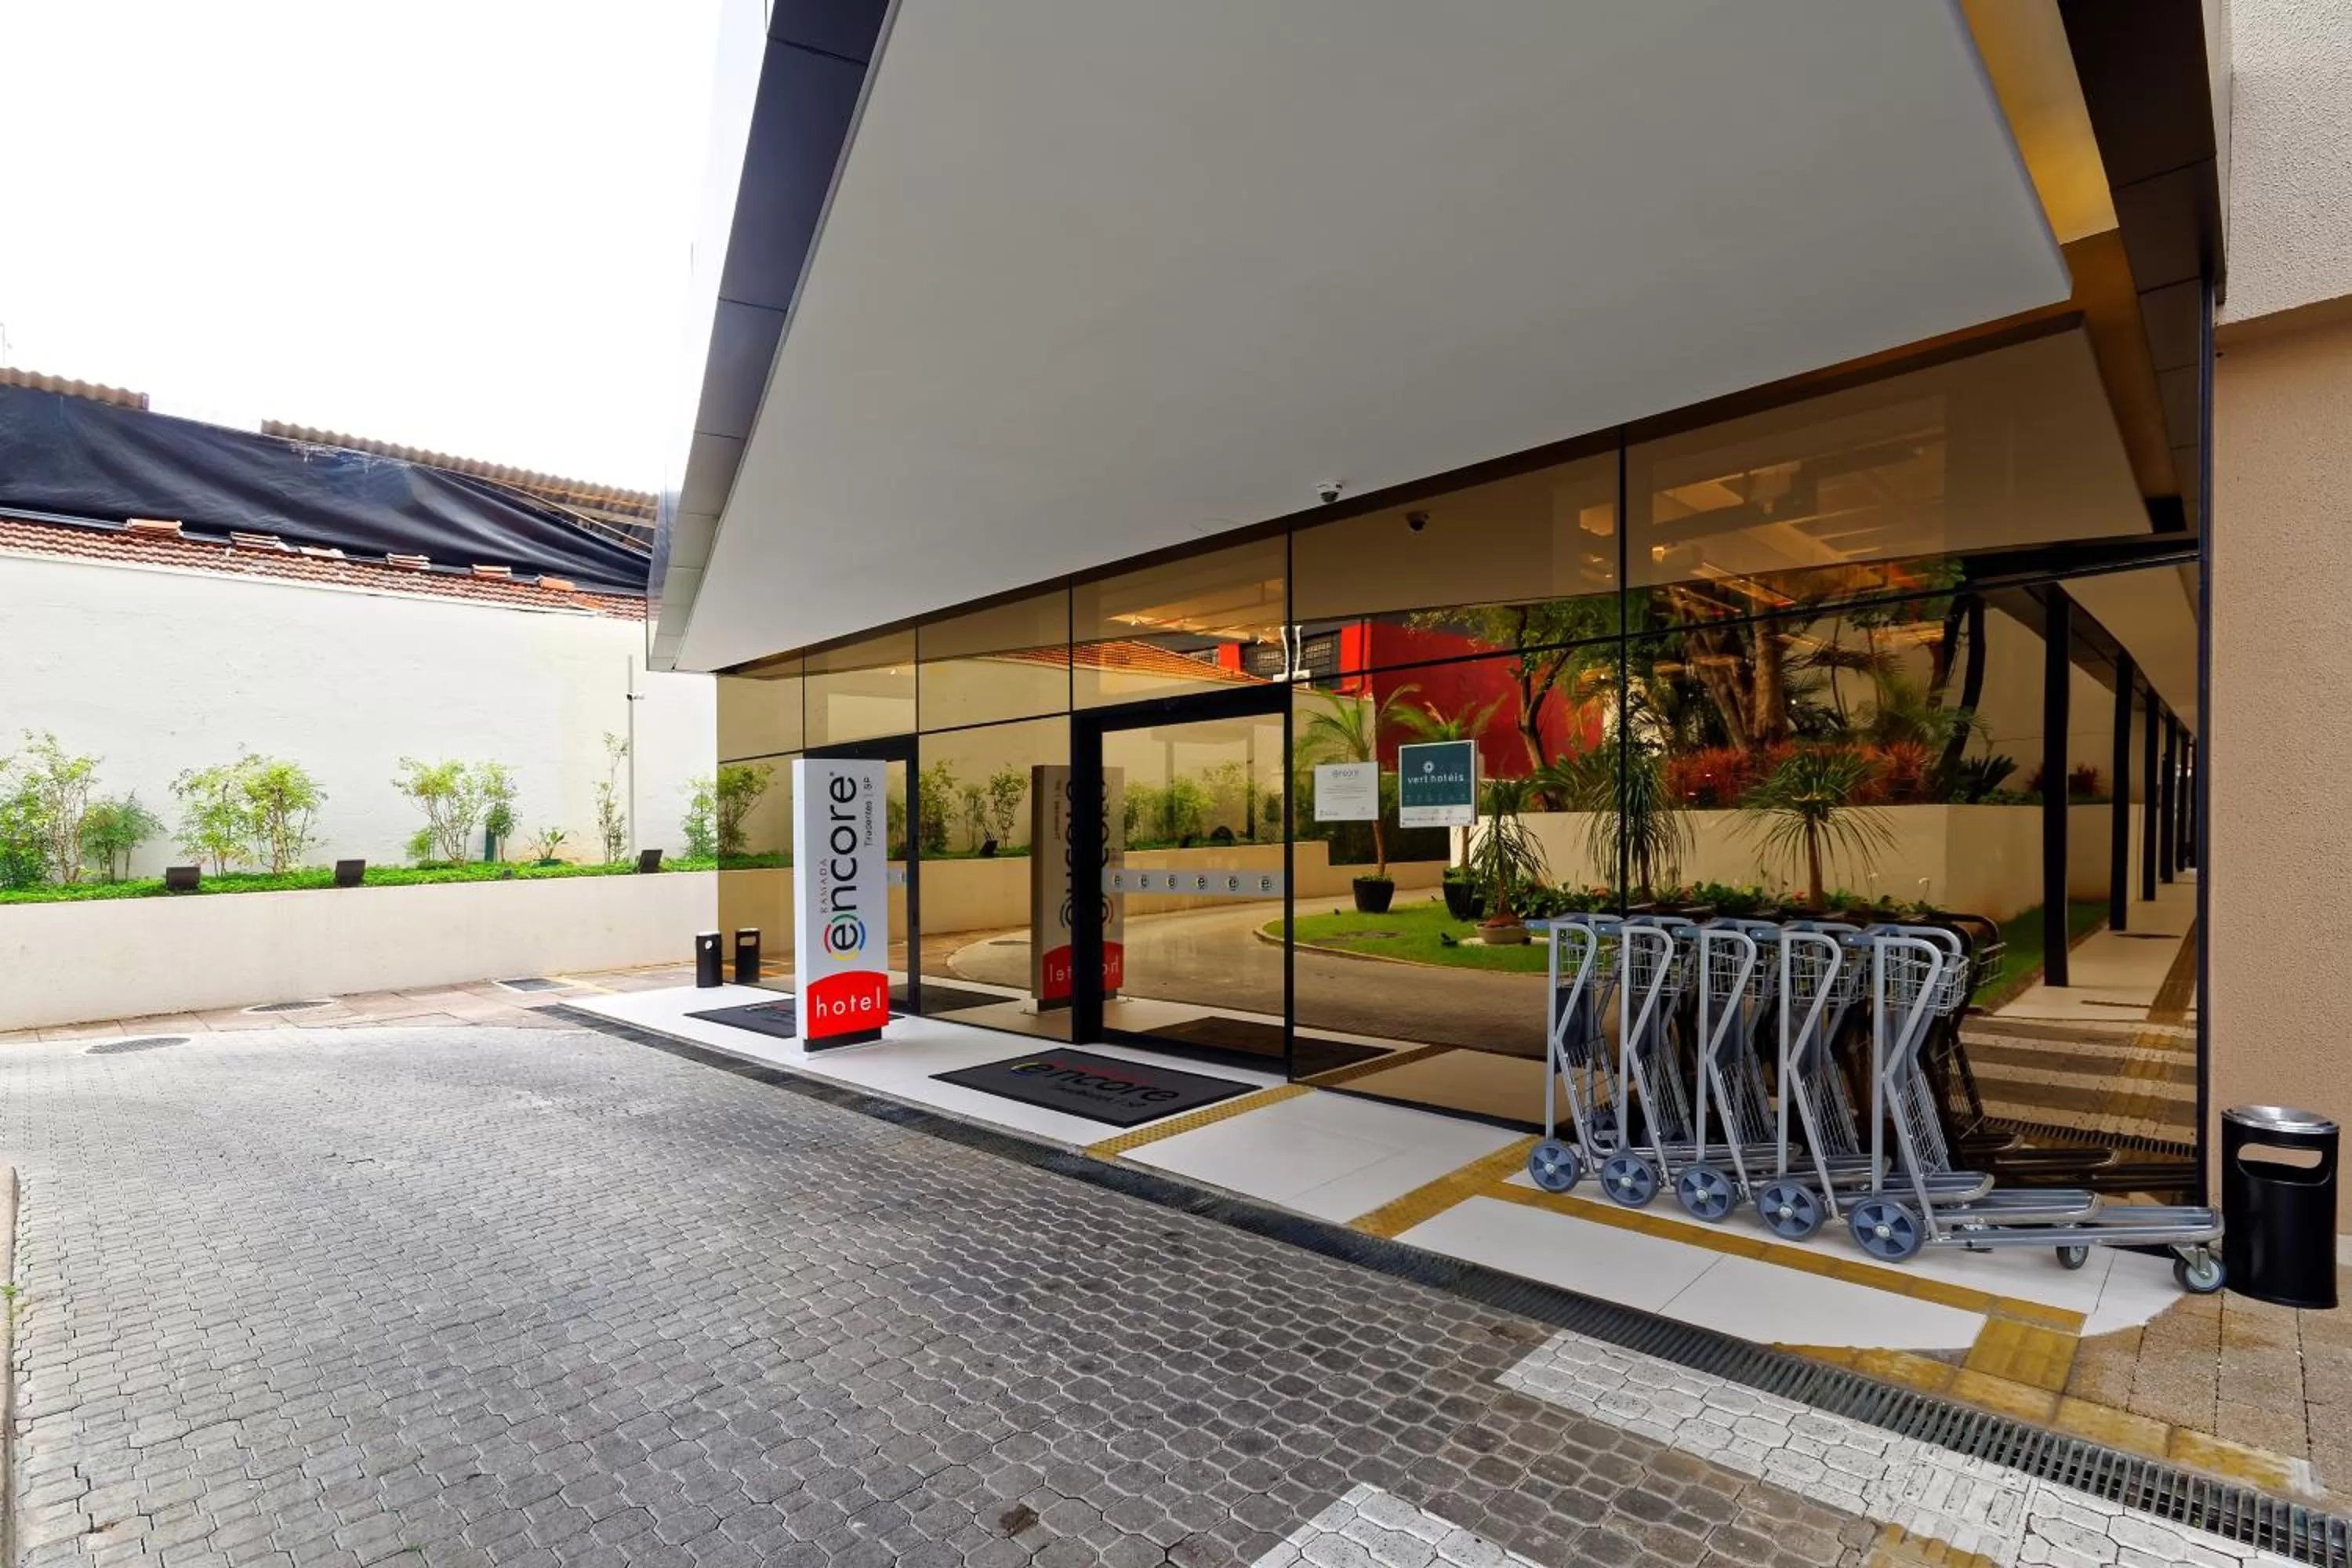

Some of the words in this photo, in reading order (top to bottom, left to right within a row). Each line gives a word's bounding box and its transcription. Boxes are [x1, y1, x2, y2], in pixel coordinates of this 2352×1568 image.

[829, 775, 858, 951] encore
[816, 985, 880, 1018] hotel
[1019, 1062, 1180, 1102] encore
